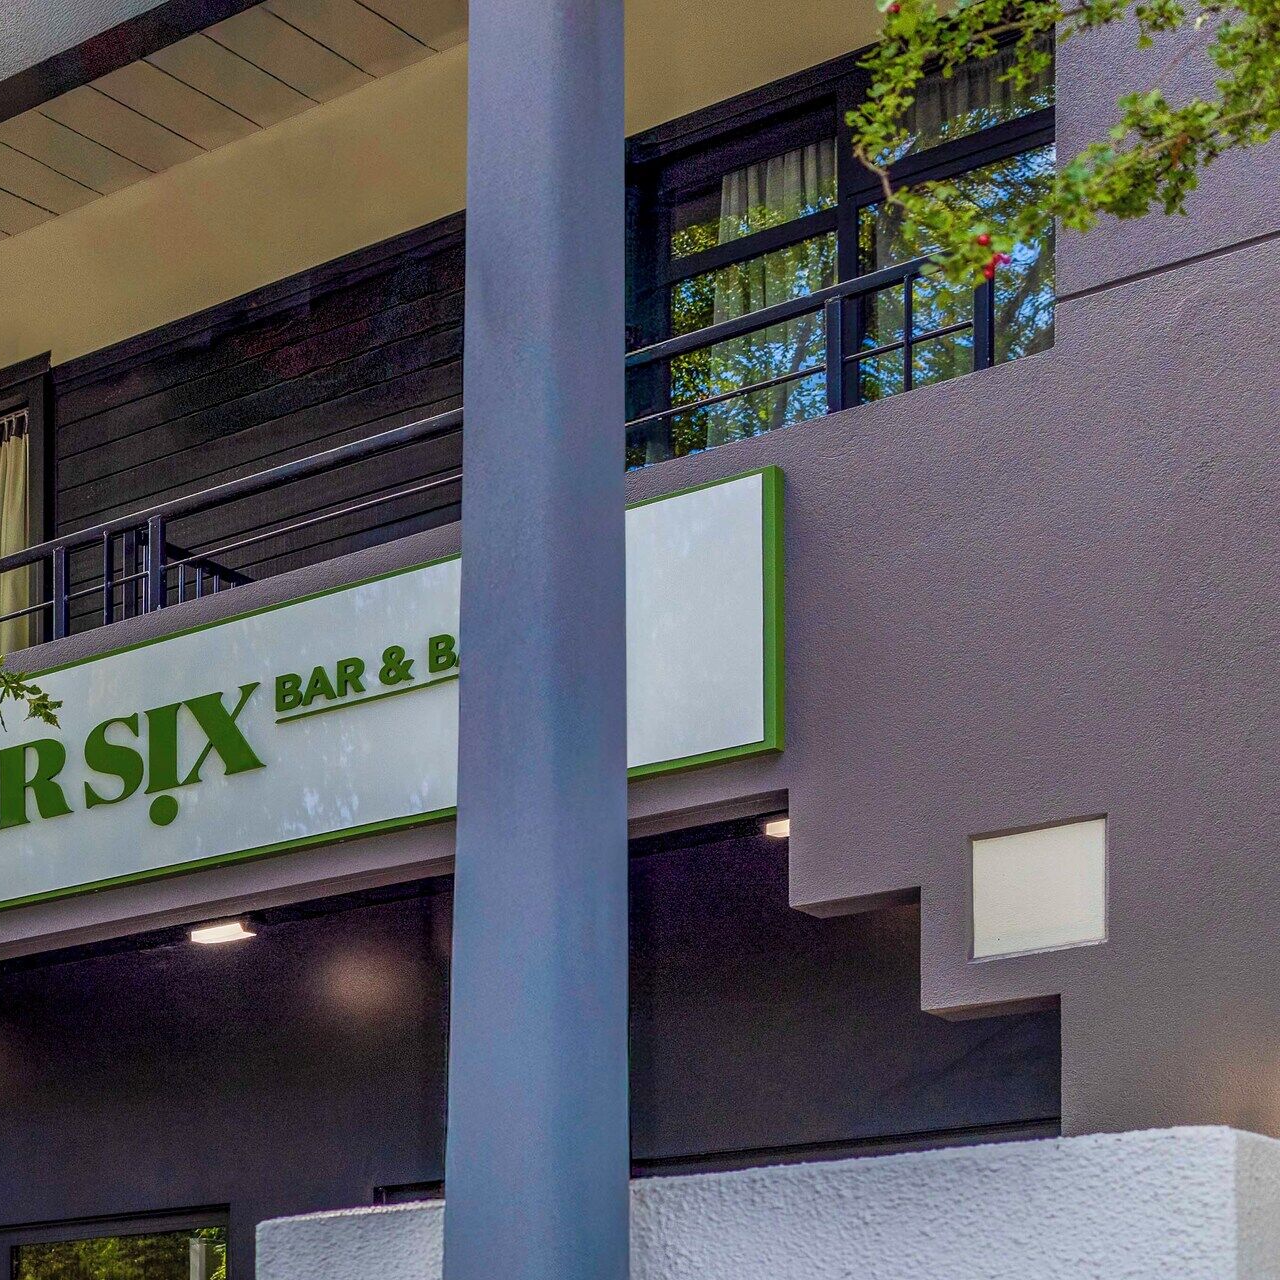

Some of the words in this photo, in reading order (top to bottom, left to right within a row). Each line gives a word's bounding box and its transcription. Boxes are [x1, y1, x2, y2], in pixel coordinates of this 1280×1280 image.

[84, 682, 267, 826] SIX
[275, 657, 366, 713] BAR
[379, 645, 415, 686] &
